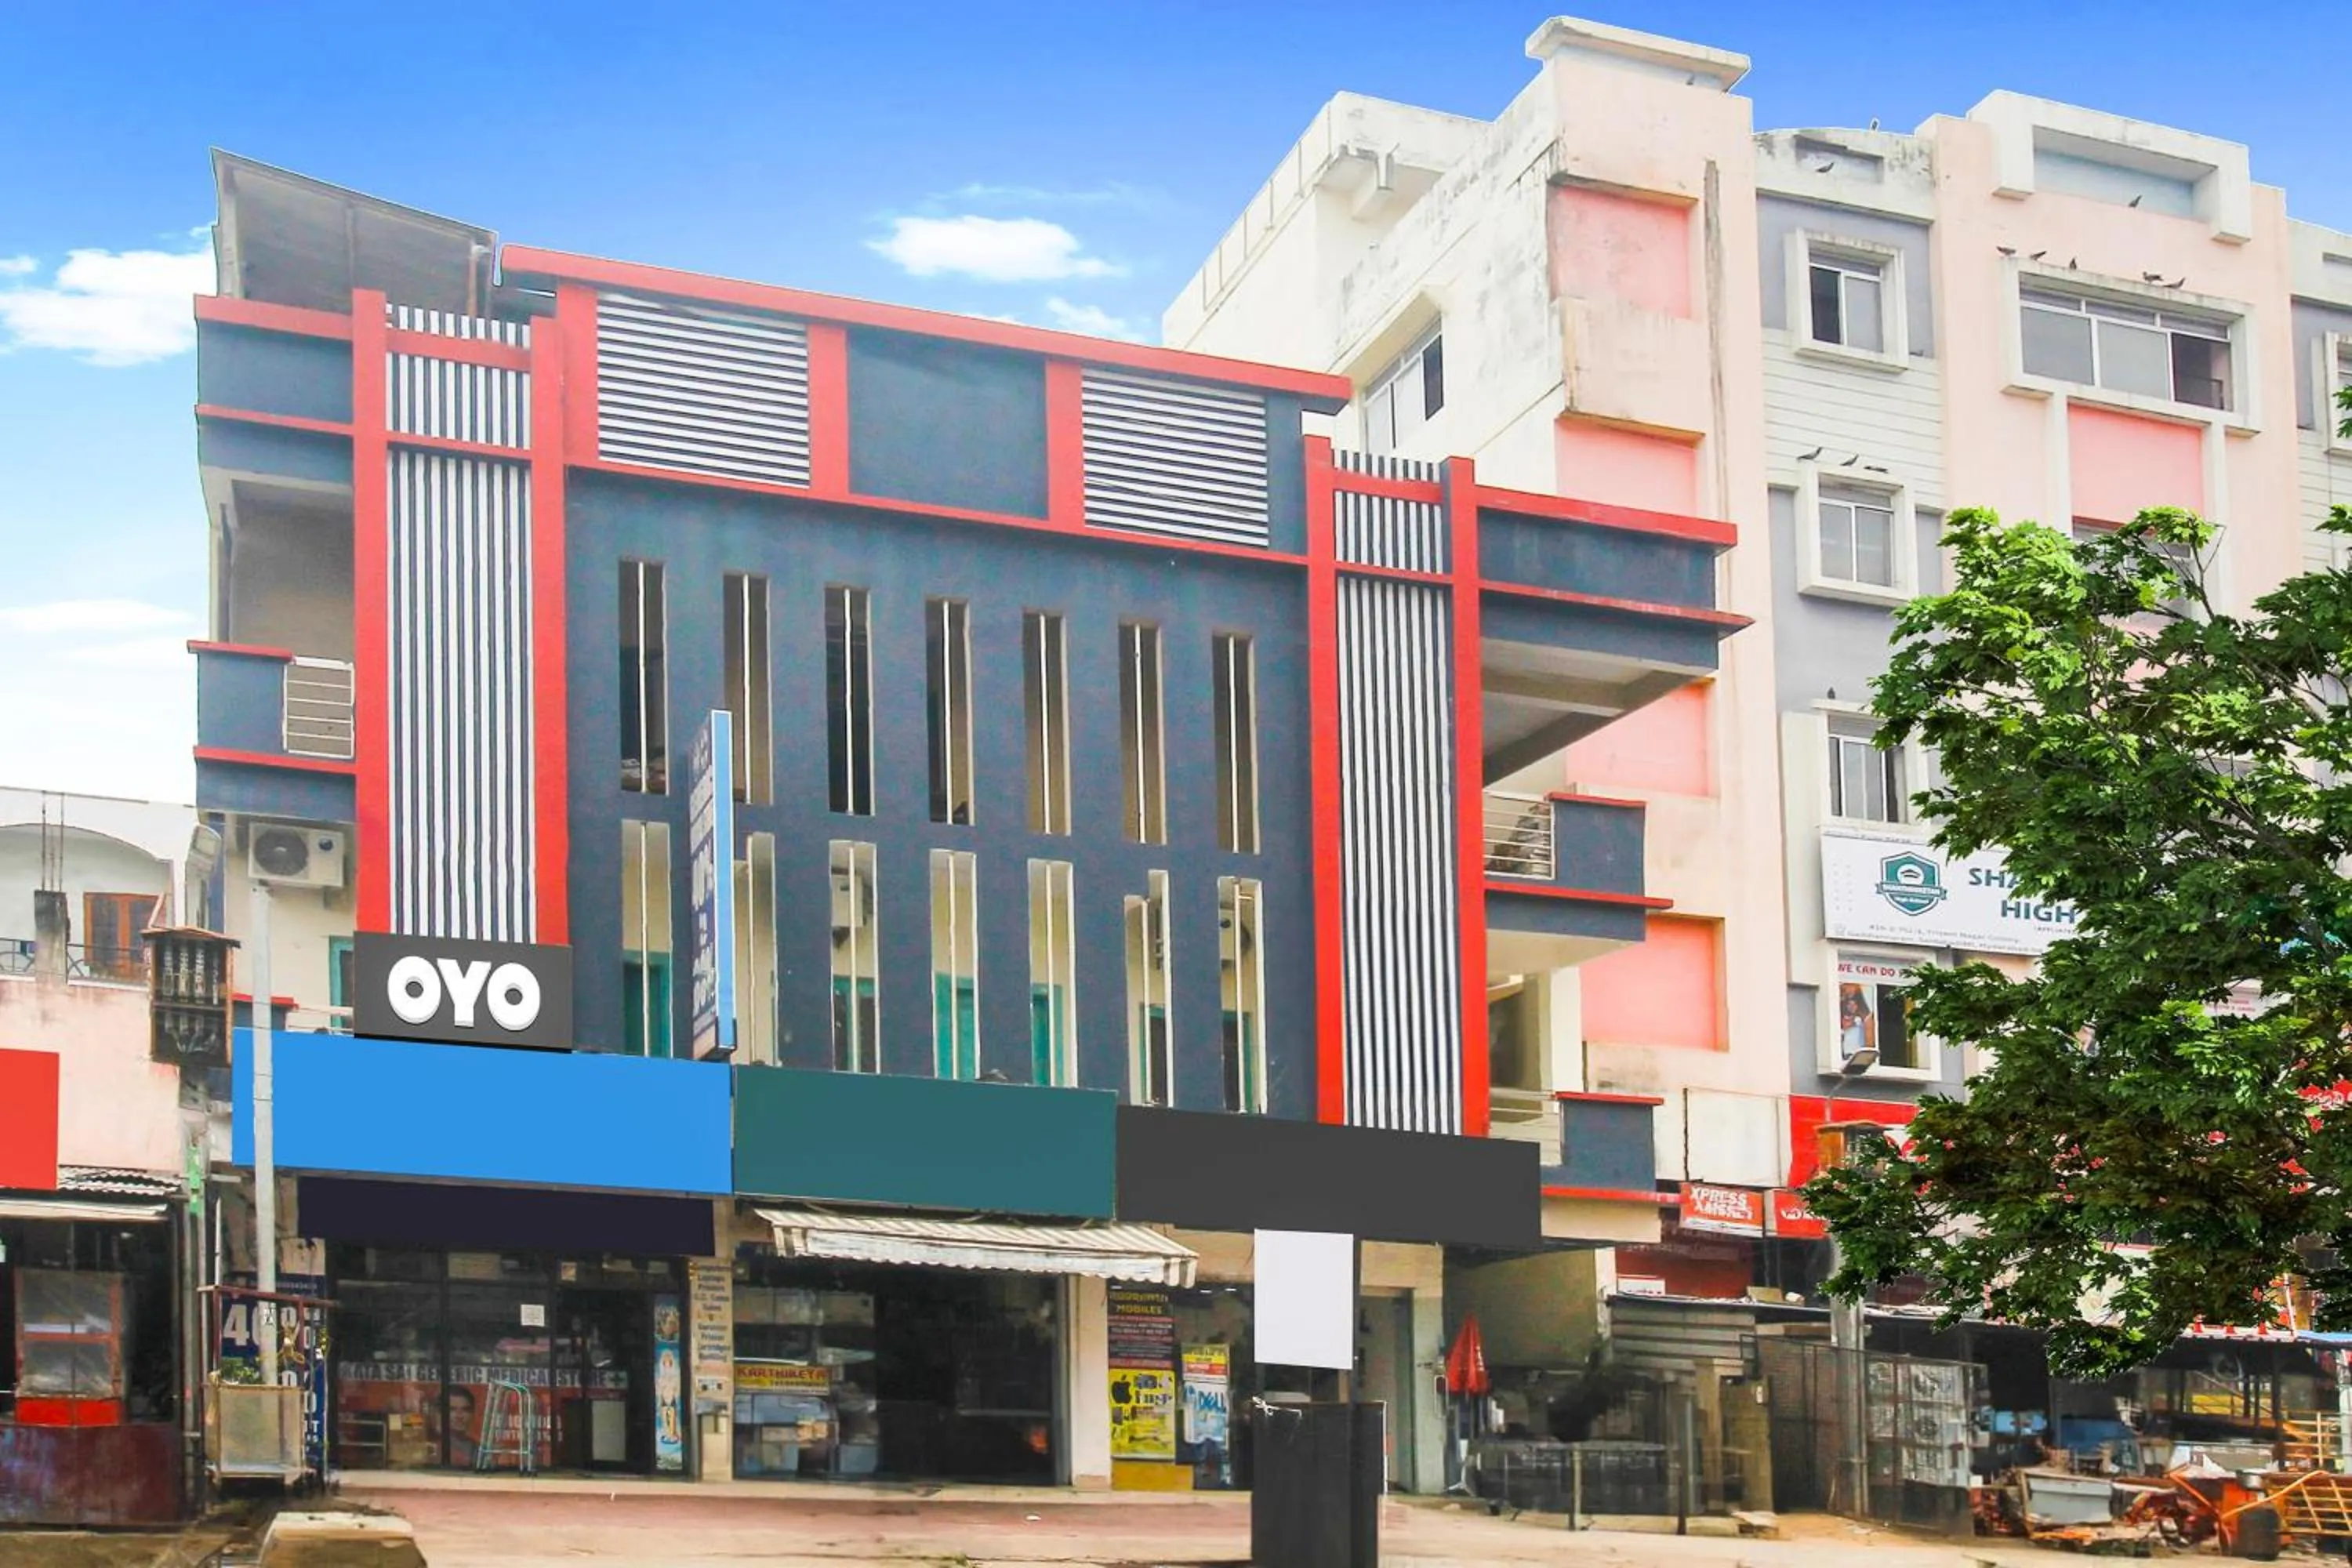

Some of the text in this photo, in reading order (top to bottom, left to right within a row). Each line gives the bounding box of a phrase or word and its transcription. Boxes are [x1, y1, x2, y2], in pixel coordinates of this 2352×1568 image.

[2001, 899, 2076, 924] HIGH
[1881, 967, 1895, 977] DO
[387, 956, 540, 1032] OYO
[487, 1367, 554, 1385] MEDICA
